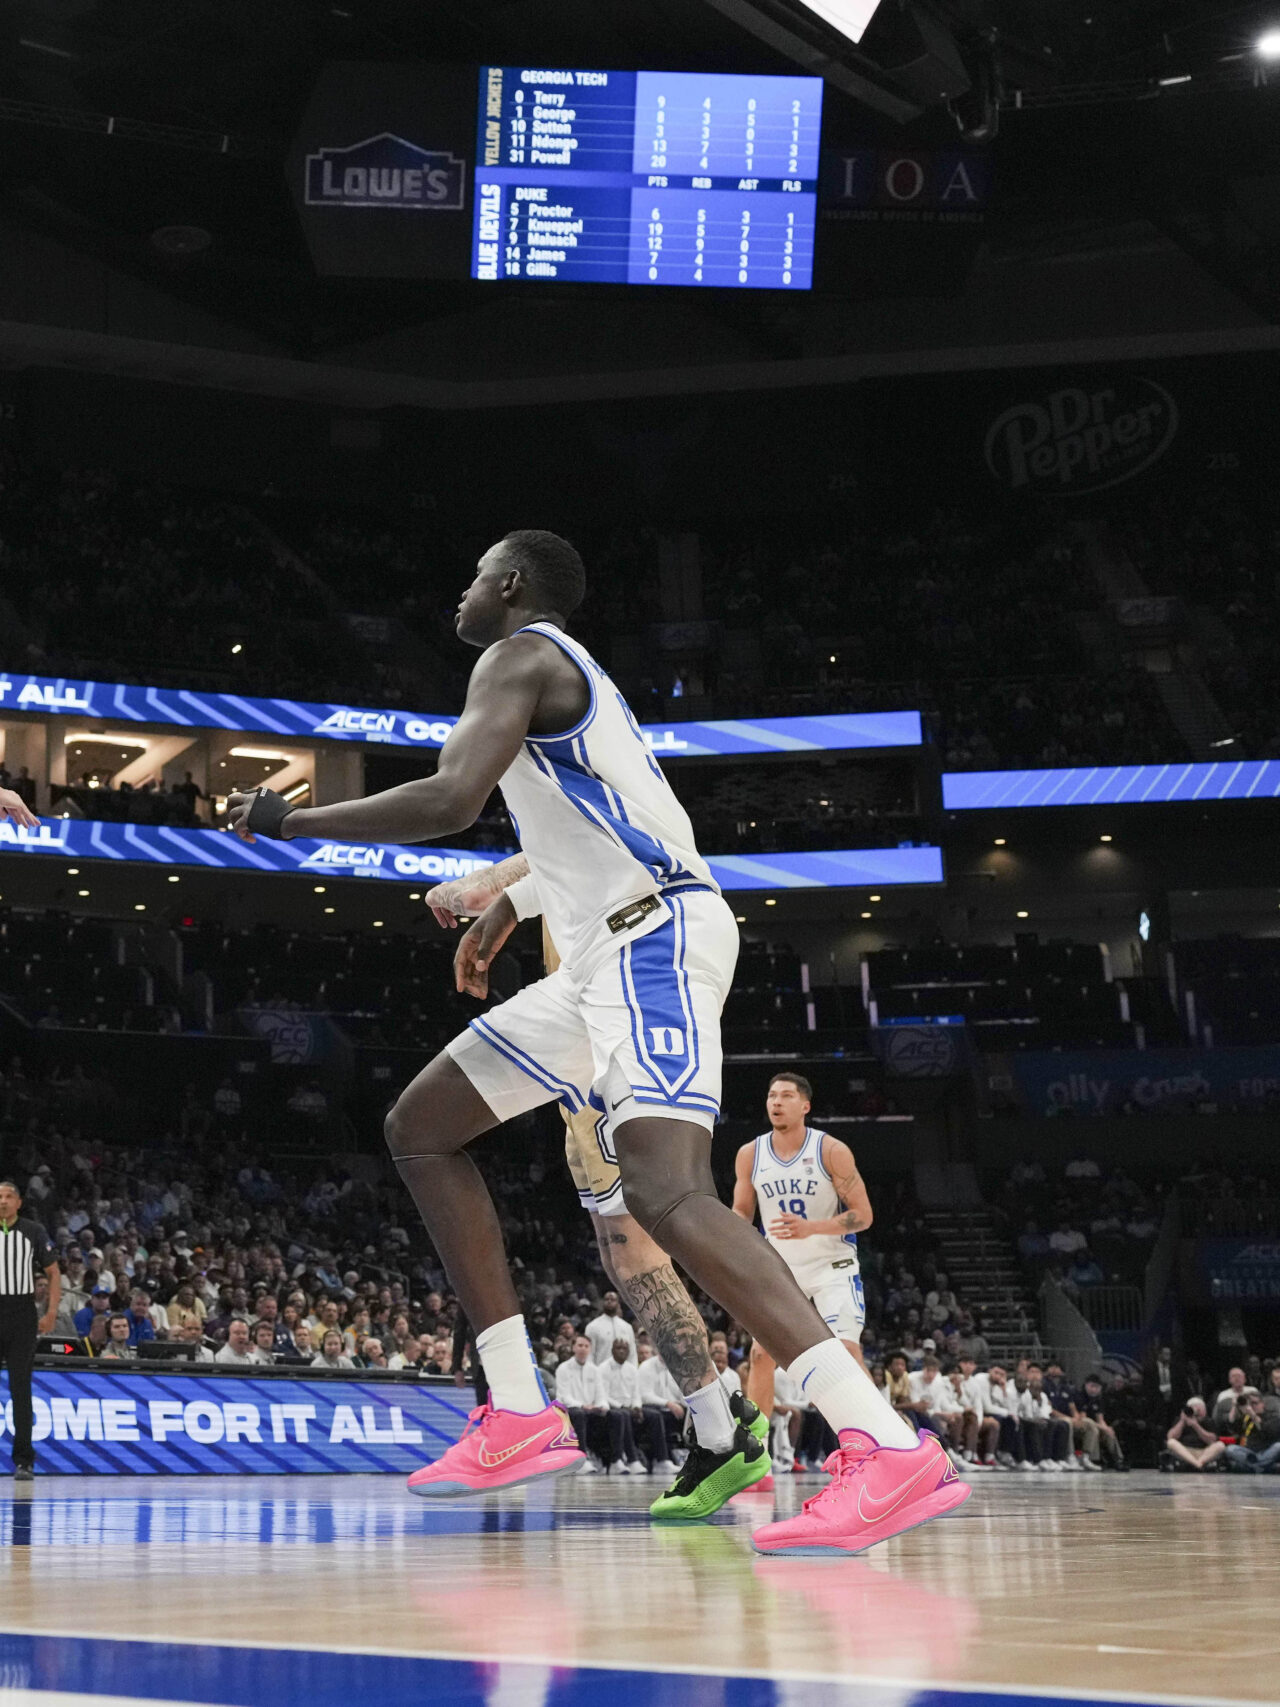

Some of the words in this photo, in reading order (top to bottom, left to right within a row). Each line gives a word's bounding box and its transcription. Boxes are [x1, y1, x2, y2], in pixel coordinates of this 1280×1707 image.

[520, 70, 574, 85] GEORGIA
[575, 72, 608, 86] TECH
[487, 68, 503, 118] JACKETS
[514, 89, 524, 103] 0
[533, 90, 566, 107] Terry
[657, 96, 666, 108] 9
[703, 97, 711, 109] 4
[748, 98, 756, 112] 0
[792, 100, 800, 113] 2
[516, 106, 523, 118] 1
[533, 106, 576, 123] George
[657, 110, 665, 123] 8
[702, 112, 711, 125] 3
[747, 113, 755, 127] 5
[792, 115, 799, 128] 1
[511, 119, 526, 133] 10
[532, 120, 571, 134] Sutton
[656, 125, 664, 138] 3
[702, 126, 710, 139] 3
[746, 127, 755, 141] 0
[792, 130, 799, 142] 1
[484, 120, 501, 165] YELLOW
[511, 134, 525, 147] 11
[531, 135, 578, 152] Ndongo
[653, 139, 667, 152] 13
[701, 140, 709, 153] 7
[746, 142, 754, 155] 3
[790, 144, 798, 157] 3
[509, 149, 525, 163] 31
[531, 150, 571, 165] Powell
[651, 155, 667, 168] 20
[700, 157, 708, 169] 4
[745, 158, 753, 171] 1
[789, 159, 797, 173] 2
[323, 160, 448, 201] LOWE'S
[648, 175, 668, 187] PTS
[692, 177, 712, 189] REB
[738, 179, 759, 191] AST
[782, 180, 801, 192] FLS
[515, 187, 548, 201] DUKE
[479, 184, 501, 240] DEVILS
[510, 202, 519, 216] 5
[529, 203, 573, 217] Proctor
[651, 208, 660, 221] 6
[698, 209, 706, 222] 5
[742, 210, 750, 224] 3
[787, 212, 794, 225] 1
[510, 217, 519, 231] 7
[528, 218, 583, 235] Knueppel
[648, 222, 663, 236] 19
[697, 224, 705, 237] 5
[741, 225, 750, 239] 7
[786, 227, 793, 240] 1
[509, 232, 518, 245] 9
[527, 232, 577, 247] Maluach
[648, 237, 662, 250] 12
[696, 238, 704, 251] 9
[740, 239, 749, 253] 0
[784, 241, 793, 254] 3
[477, 242, 498, 280] BLUE
[505, 247, 520, 260] 14
[526, 247, 566, 261] James
[650, 251, 659, 264] 7
[695, 253, 703, 266] 4
[739, 254, 748, 268] 3
[784, 255, 792, 269] 3
[505, 262, 520, 275] 18
[526, 262, 557, 277] Gillis
[649, 266, 658, 280] 0
[694, 268, 703, 281] 4
[738, 270, 747, 283] 0
[783, 271, 791, 284] 0
[1048, 388, 1116, 438] Dr
[984, 402, 1162, 488] Pepper
[17, 683, 89, 708] ALL
[321, 710, 396, 732] ACCN
[405, 720, 456, 743] CO
[644, 731, 688, 750] LL
[308, 844, 385, 867] ACCN
[761, 1179, 818, 1199] DUKE
[778, 1198, 808, 1221] 18
[148, 1399, 262, 1444] FOR
[269, 1403, 317, 1443] IT
[328, 1405, 424, 1445] ALL
